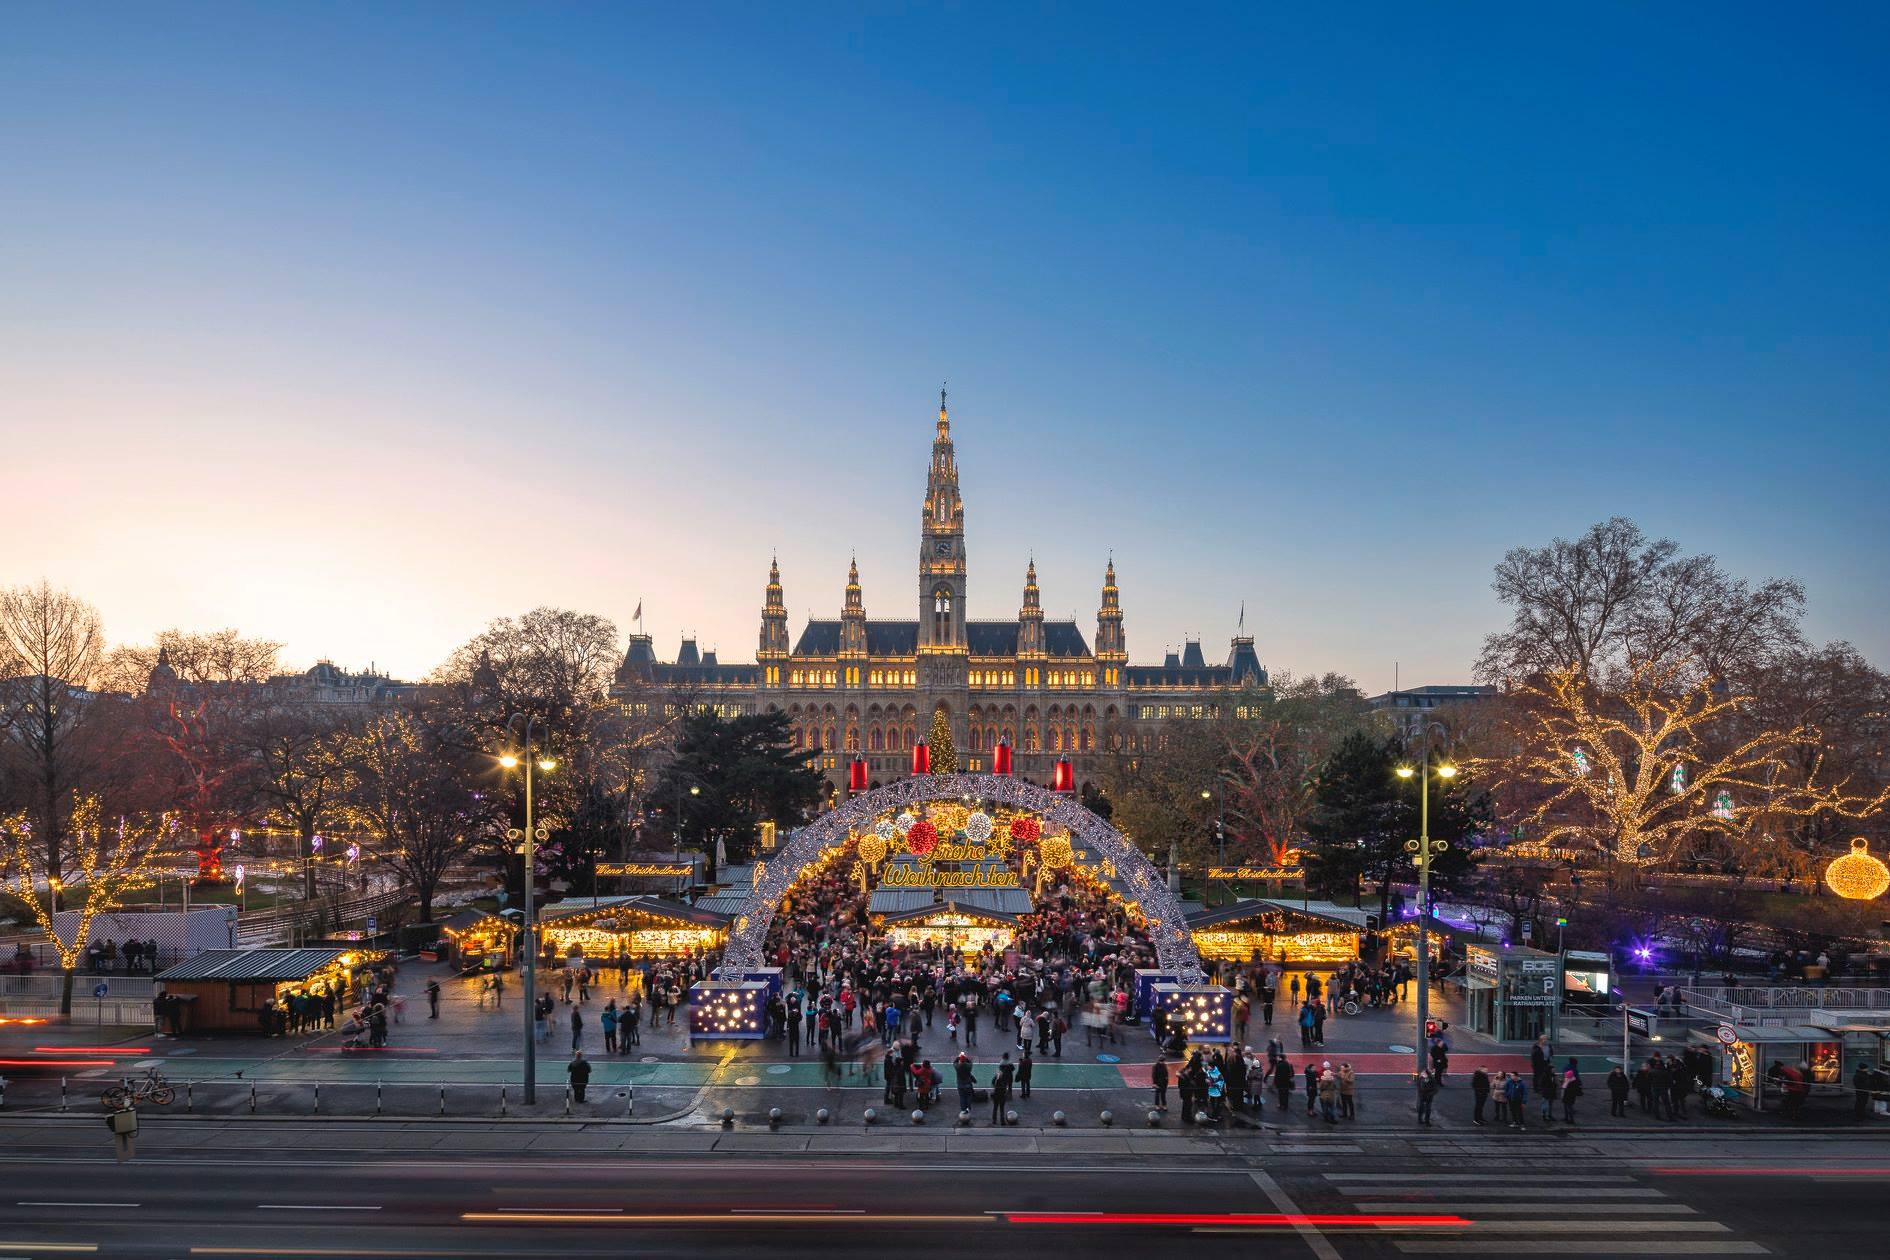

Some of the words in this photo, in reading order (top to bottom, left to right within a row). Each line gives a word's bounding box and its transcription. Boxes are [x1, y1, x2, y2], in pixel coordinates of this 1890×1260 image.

[918, 836, 985, 863] Frohe
[595, 864, 623, 875] Wiener
[883, 863, 1019, 886] Weihnachten
[1208, 868, 1236, 878] Wiener
